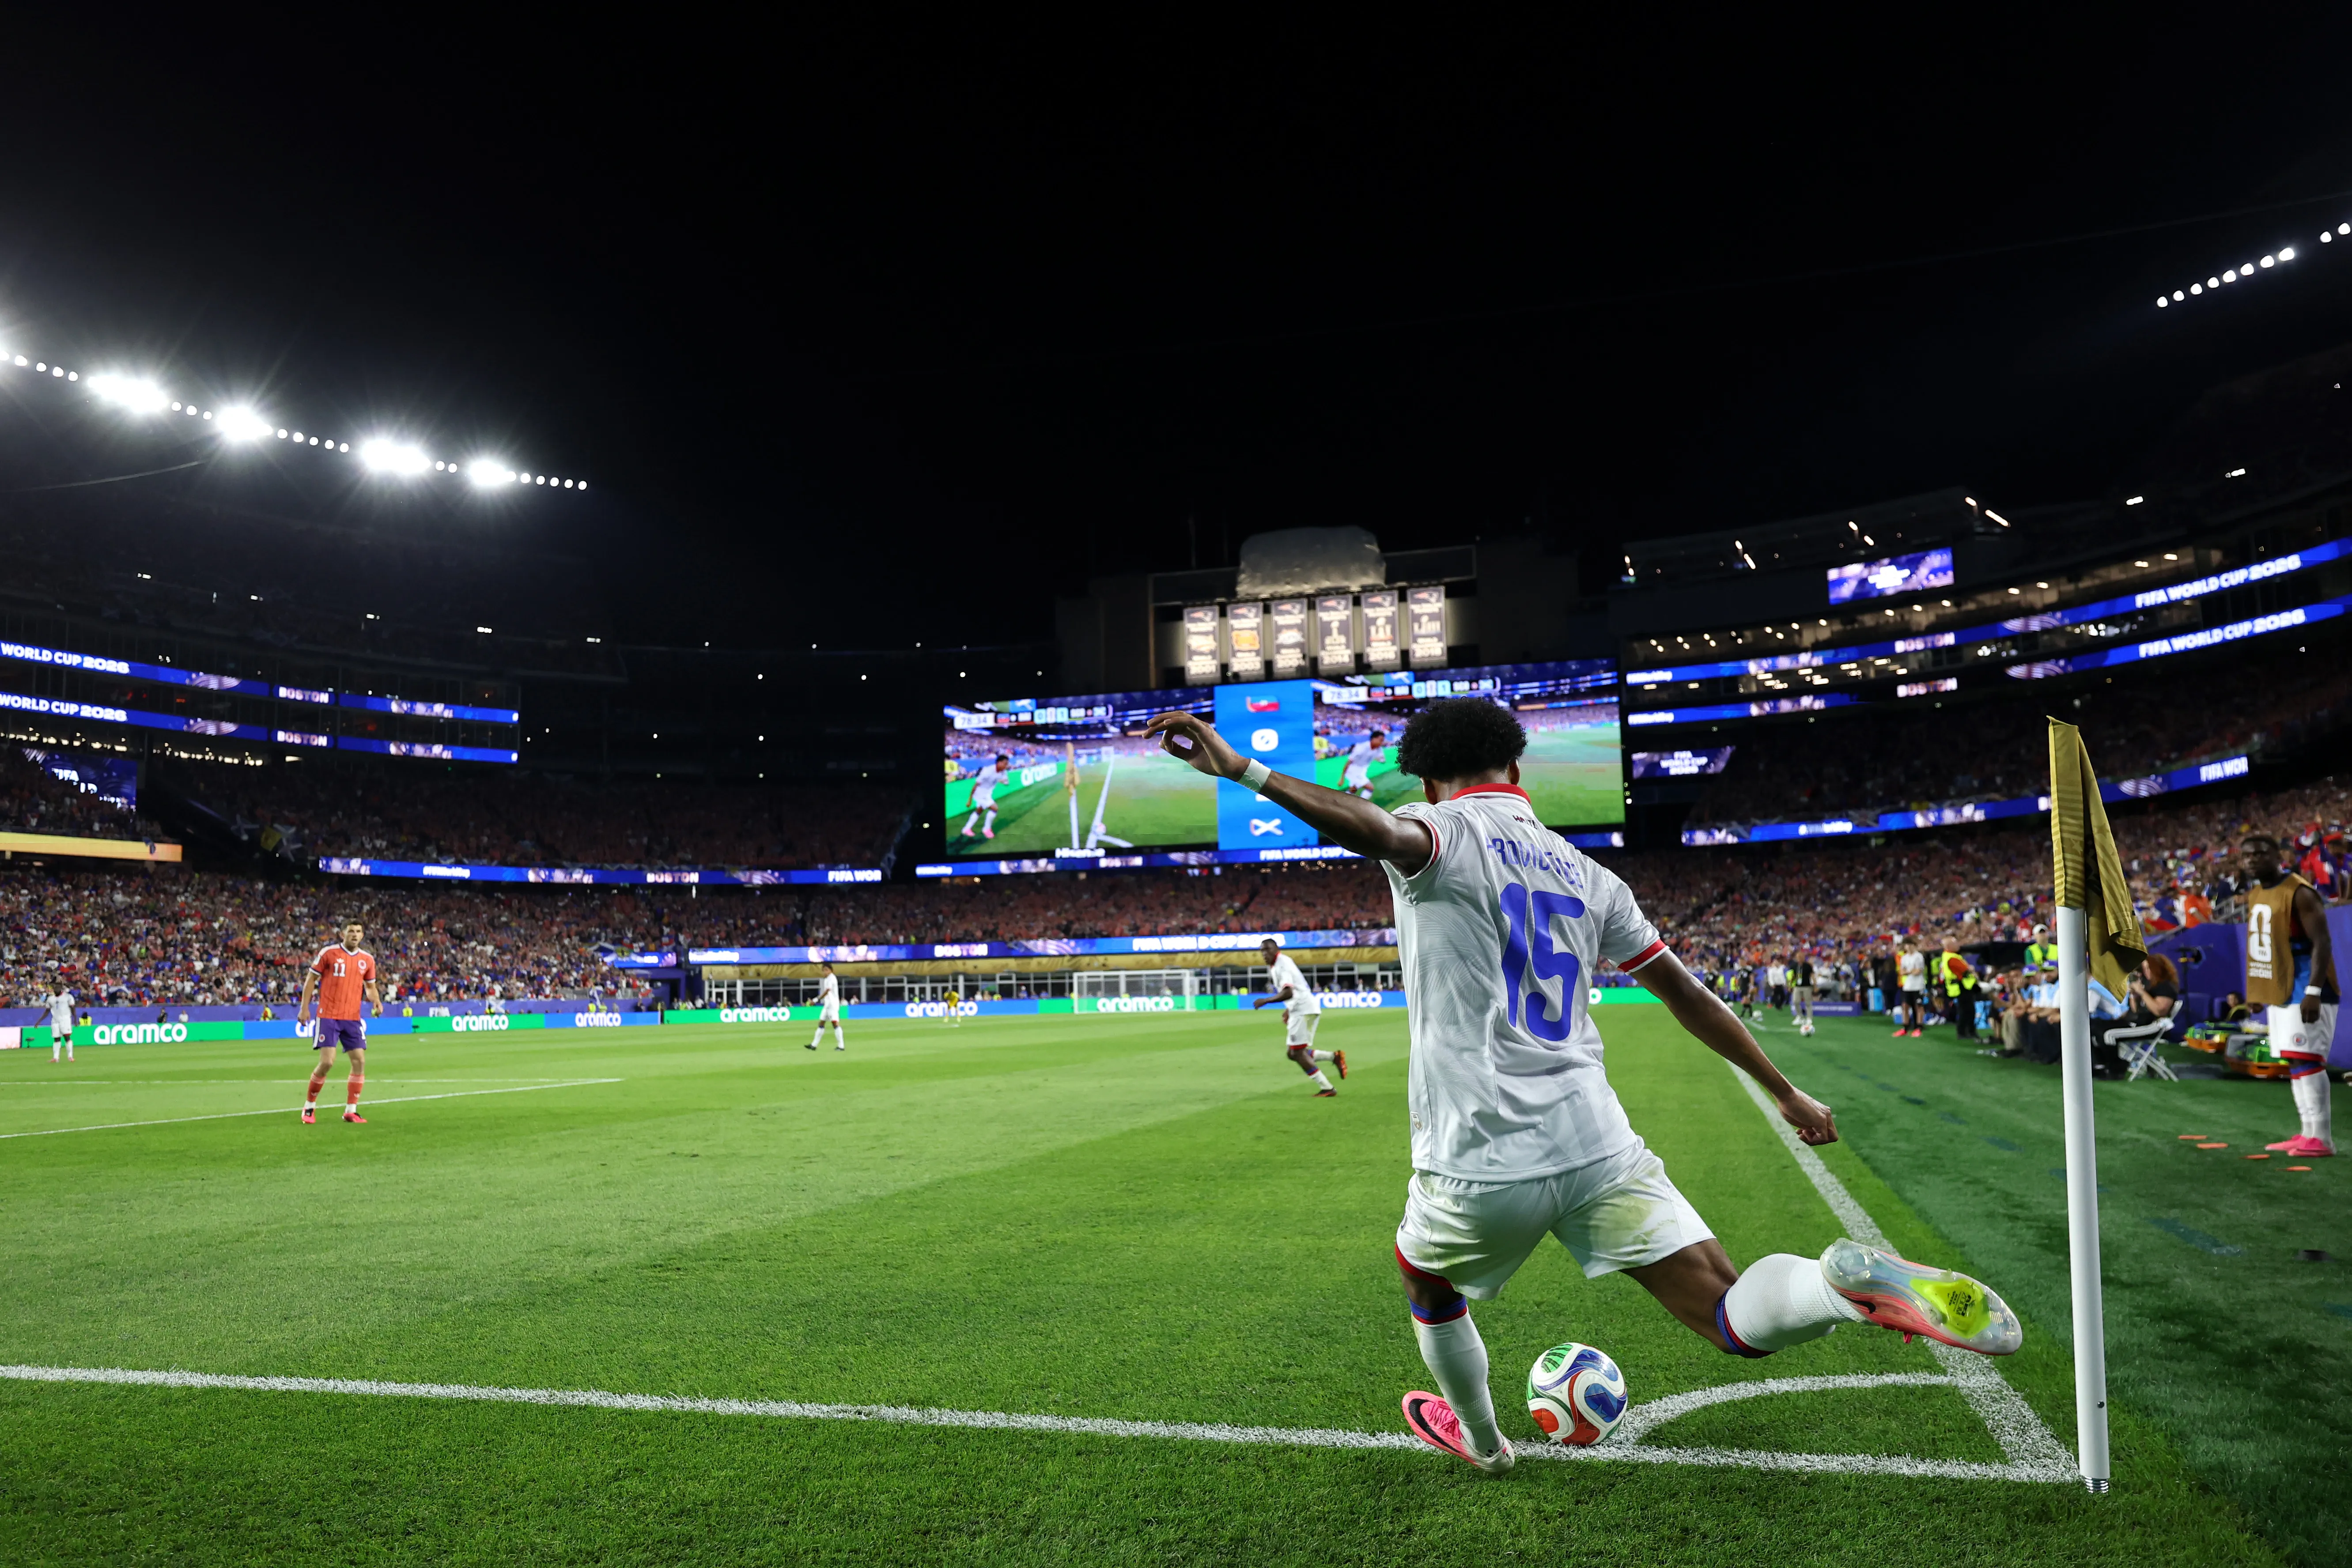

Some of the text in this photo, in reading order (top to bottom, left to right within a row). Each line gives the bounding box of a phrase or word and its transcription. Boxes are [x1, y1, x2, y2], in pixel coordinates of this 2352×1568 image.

[2135, 554, 2302, 608] FIFA WORLD CUP 2026
[2139, 608, 2307, 658] FIFA WORLD CUP 2026
[1895, 632, 1955, 654] BOSTON
[0, 642, 131, 674] WORLD CUP 2026
[279, 686, 329, 704] BOSTON
[1897, 677, 1958, 698] BOSTON
[0, 694, 128, 722] WORLD CUP 2026
[277, 730, 328, 747] BOSTON
[2200, 762, 2224, 782] FIFA
[1259, 849, 1283, 861] FIFA
[1282, 847, 1321, 860] WORLD
[1321, 846, 1343, 858] CUP
[646, 872, 699, 883] BOSTON
[828, 870, 855, 882] FIFA
[934, 943, 988, 957] BOSTON
[333, 961, 346, 978] 11
[1500, 882, 1585, 1041] 15
[1097, 996, 1174, 1013] aramco
[1314, 992, 1383, 1008] ramco
[720, 1007, 790, 1023] aramco
[905, 1001, 979, 1017] aramco
[452, 1015, 509, 1032] aramco
[575, 1012, 622, 1028] aramco
[94, 1023, 188, 1045] aramco
